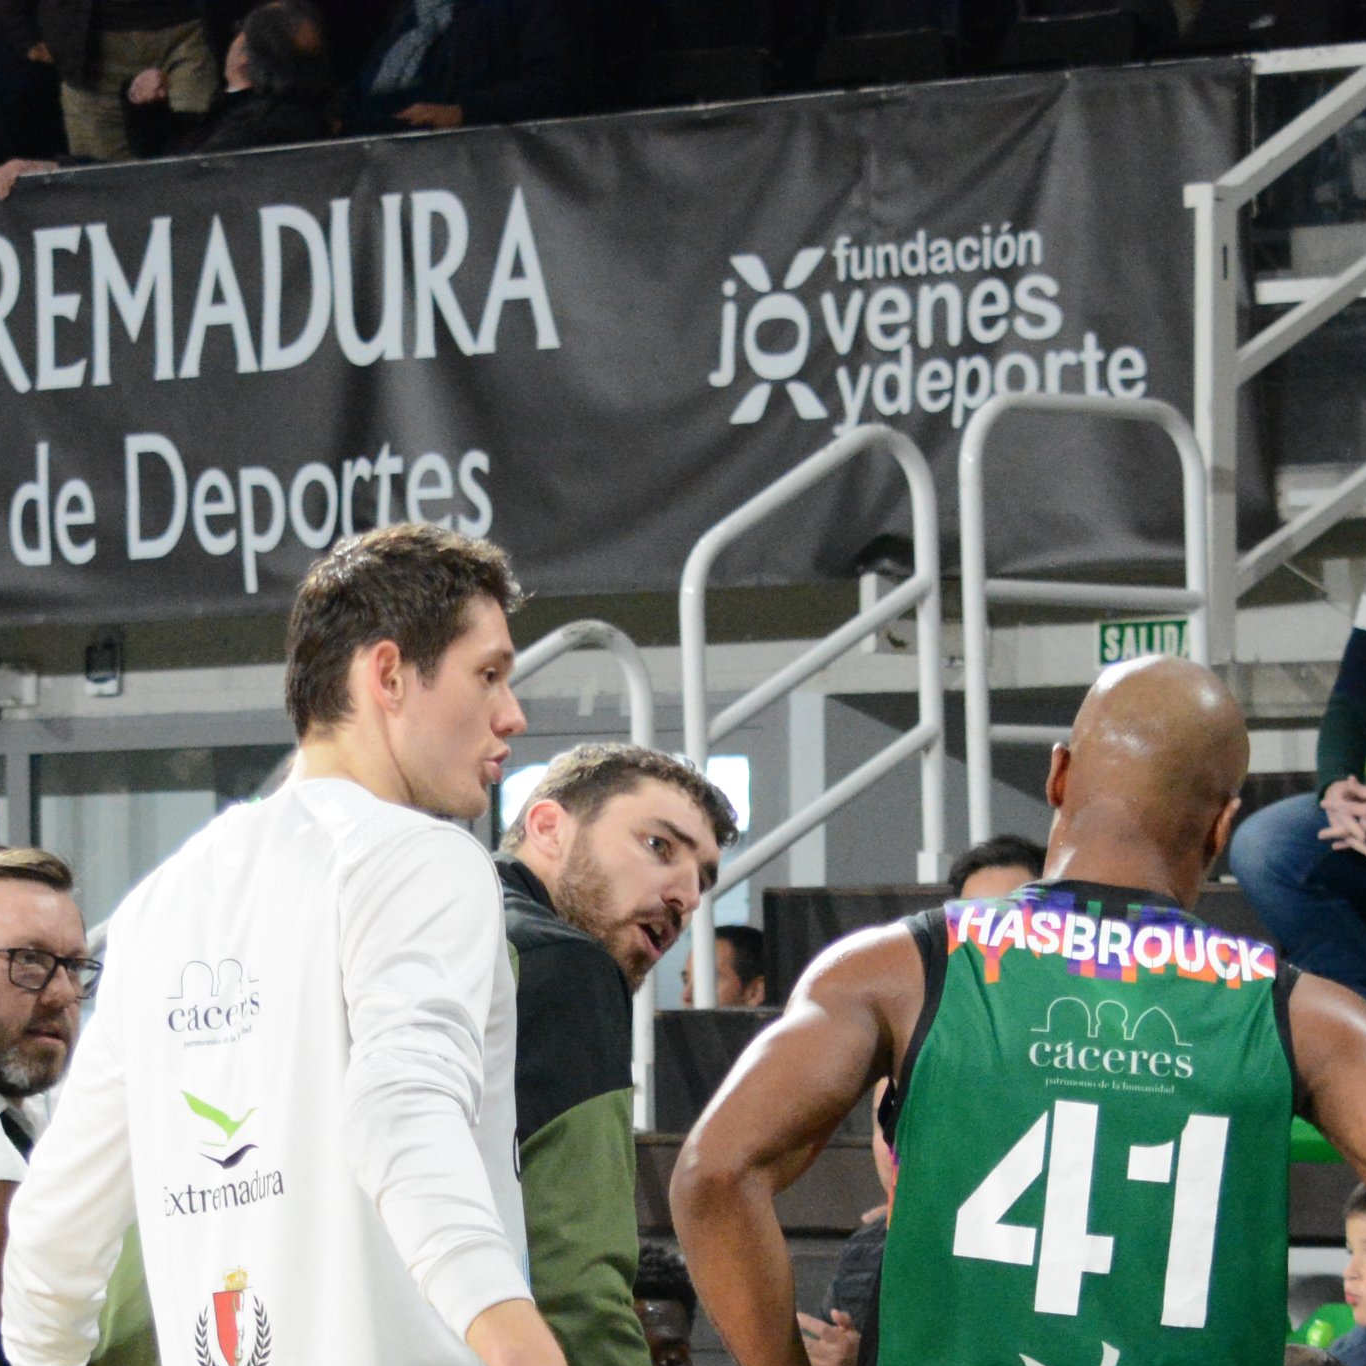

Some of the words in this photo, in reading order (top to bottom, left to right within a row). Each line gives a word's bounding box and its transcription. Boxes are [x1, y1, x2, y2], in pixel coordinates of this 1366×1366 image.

[832, 222, 1042, 282] fundación
[8, 441, 95, 567] de
[124, 433, 493, 594] Deportes
[956, 905, 1277, 982] HASBROUCK
[1028, 1040, 1194, 1079] cáceres
[952, 1100, 1231, 1329] 41
